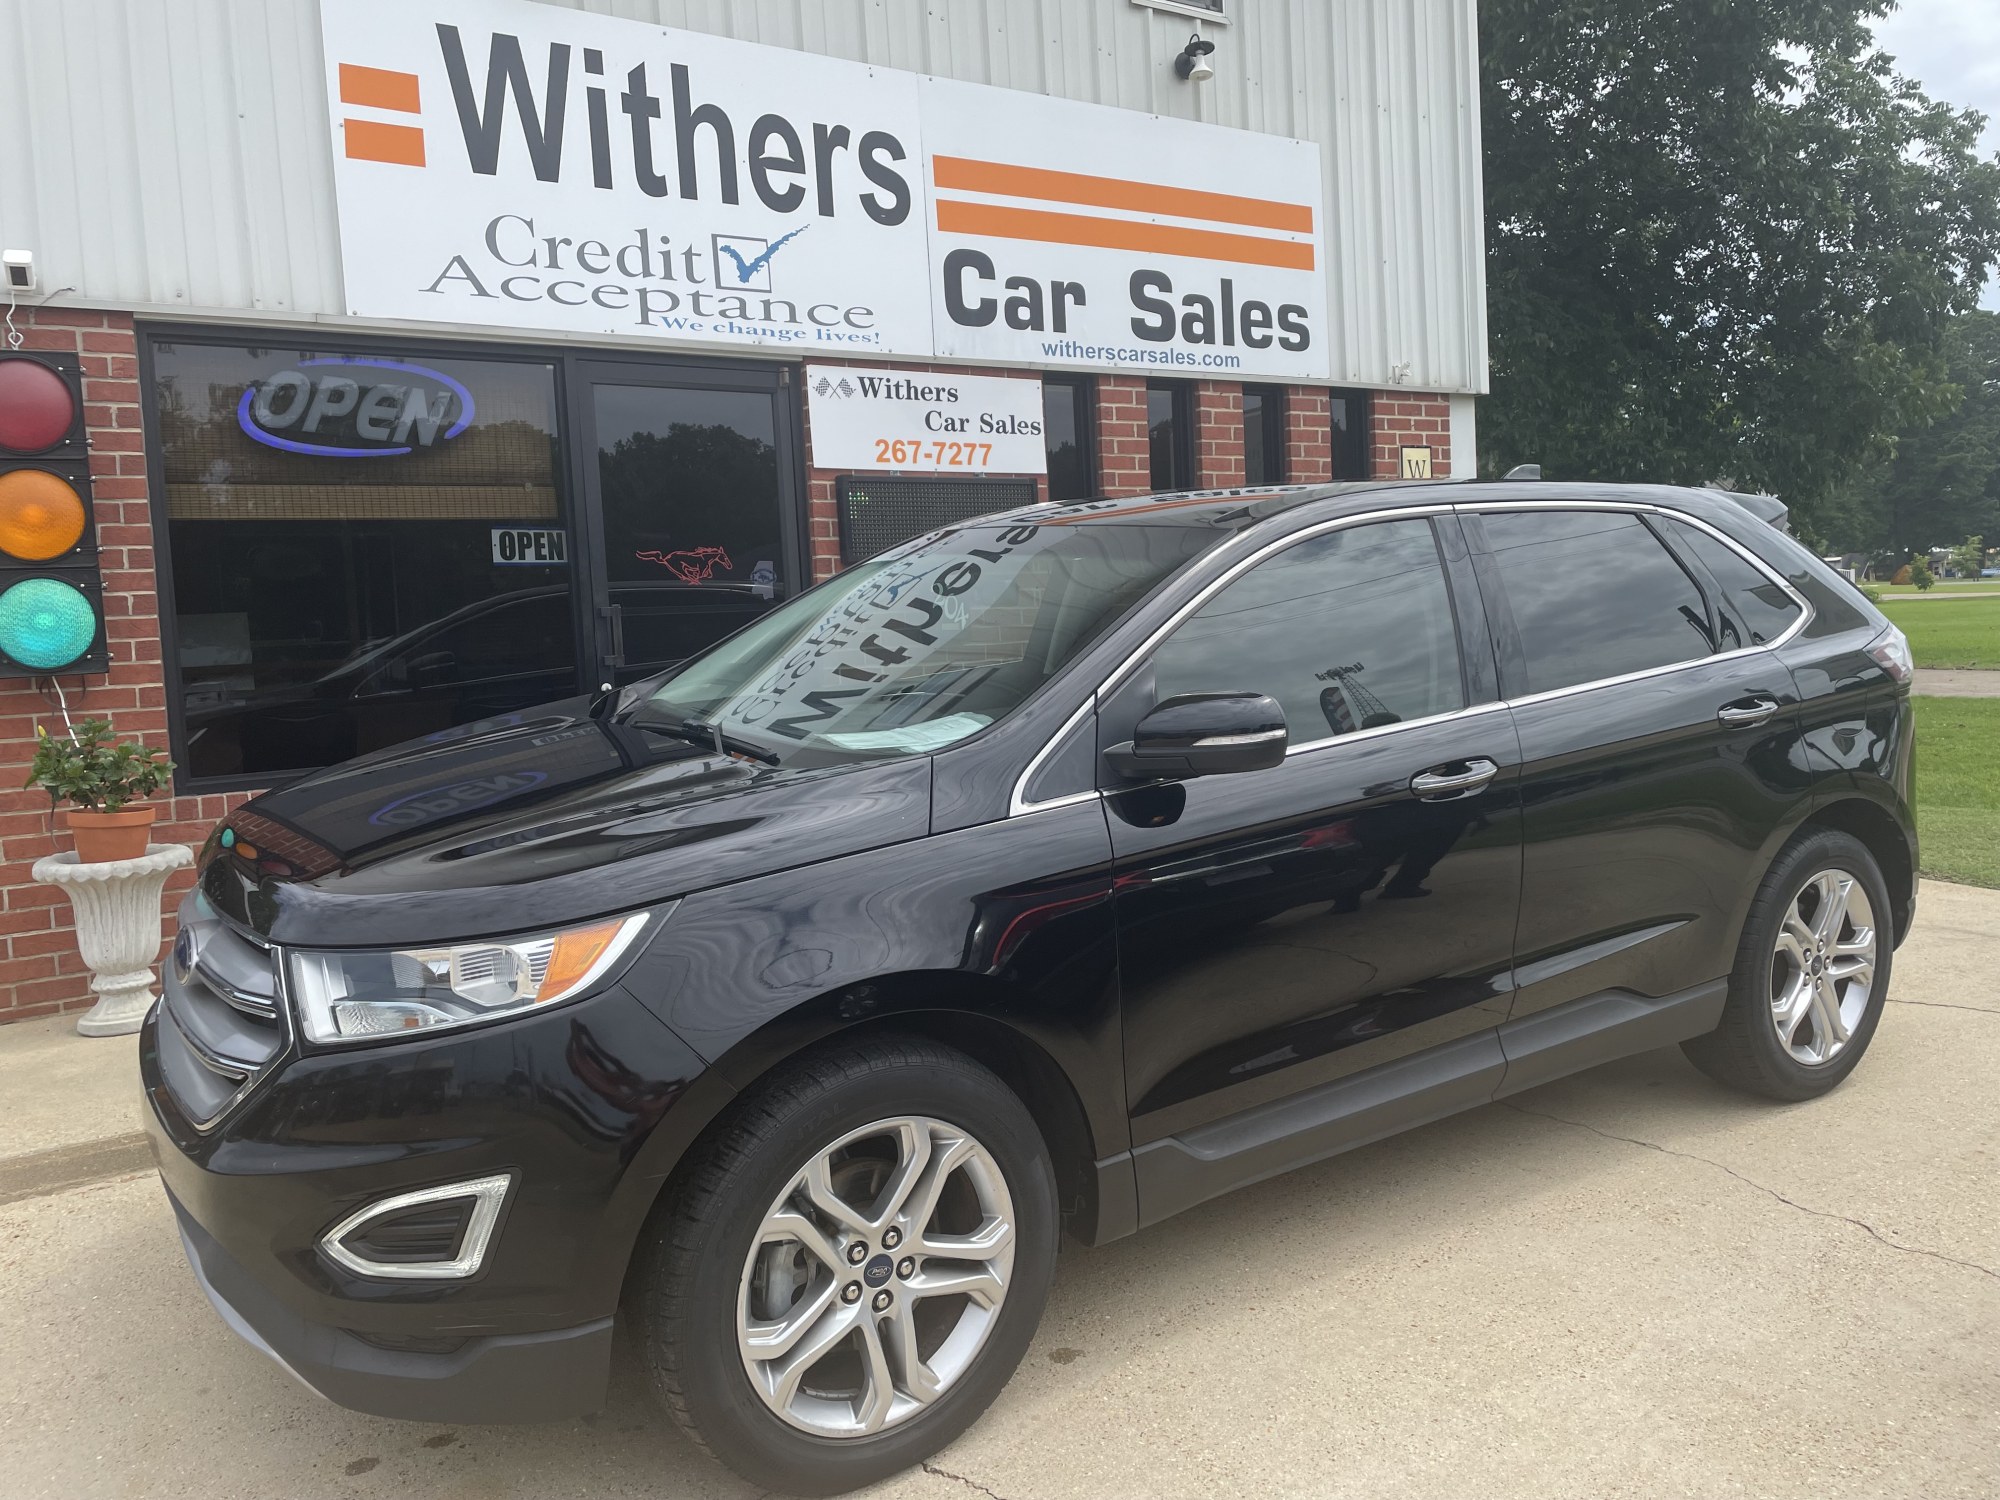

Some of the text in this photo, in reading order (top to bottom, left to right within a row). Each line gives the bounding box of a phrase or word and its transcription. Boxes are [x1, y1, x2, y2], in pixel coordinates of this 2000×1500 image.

[435, 22, 911, 226] Withers
[485, 214, 706, 284] Credit
[418, 254, 875, 329] Acceptance
[942, 248, 1311, 351] Car Sales
[659, 315, 880, 344] We change lives!
[1041, 340, 1240, 367] witherscarsales.com
[857, 376, 959, 402] Withers
[255, 370, 452, 447] OPEN
[925, 410, 1042, 435] Car Sales
[874, 439, 992, 466] 267-7277
[499, 530, 564, 561] OPEN
